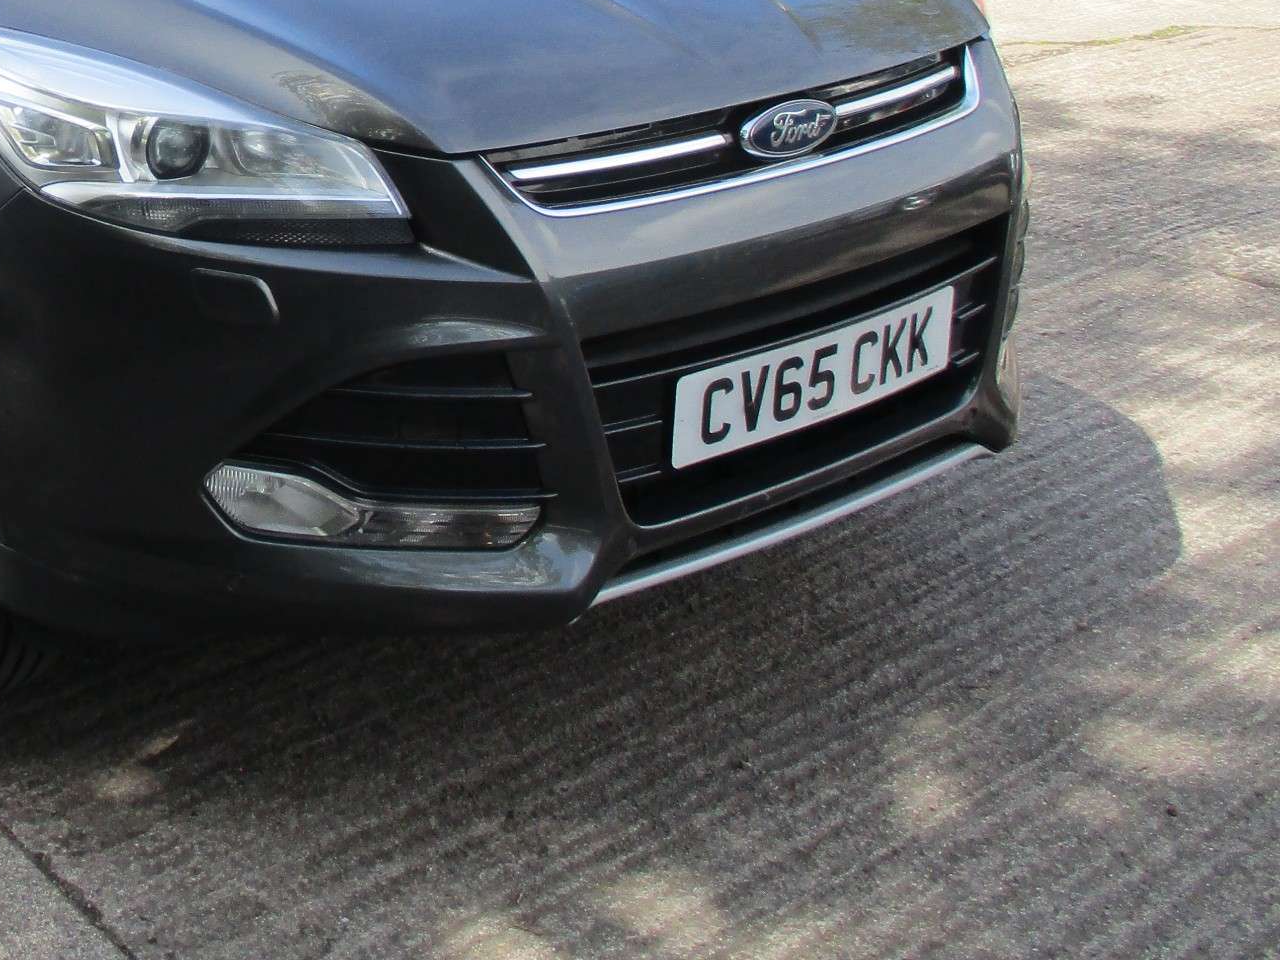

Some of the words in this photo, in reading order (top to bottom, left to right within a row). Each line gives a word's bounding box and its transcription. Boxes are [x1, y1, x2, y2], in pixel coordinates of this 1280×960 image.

[770, 108, 824, 147] Ford
[701, 343, 838, 445] CV65
[850, 306, 932, 394] CKK
